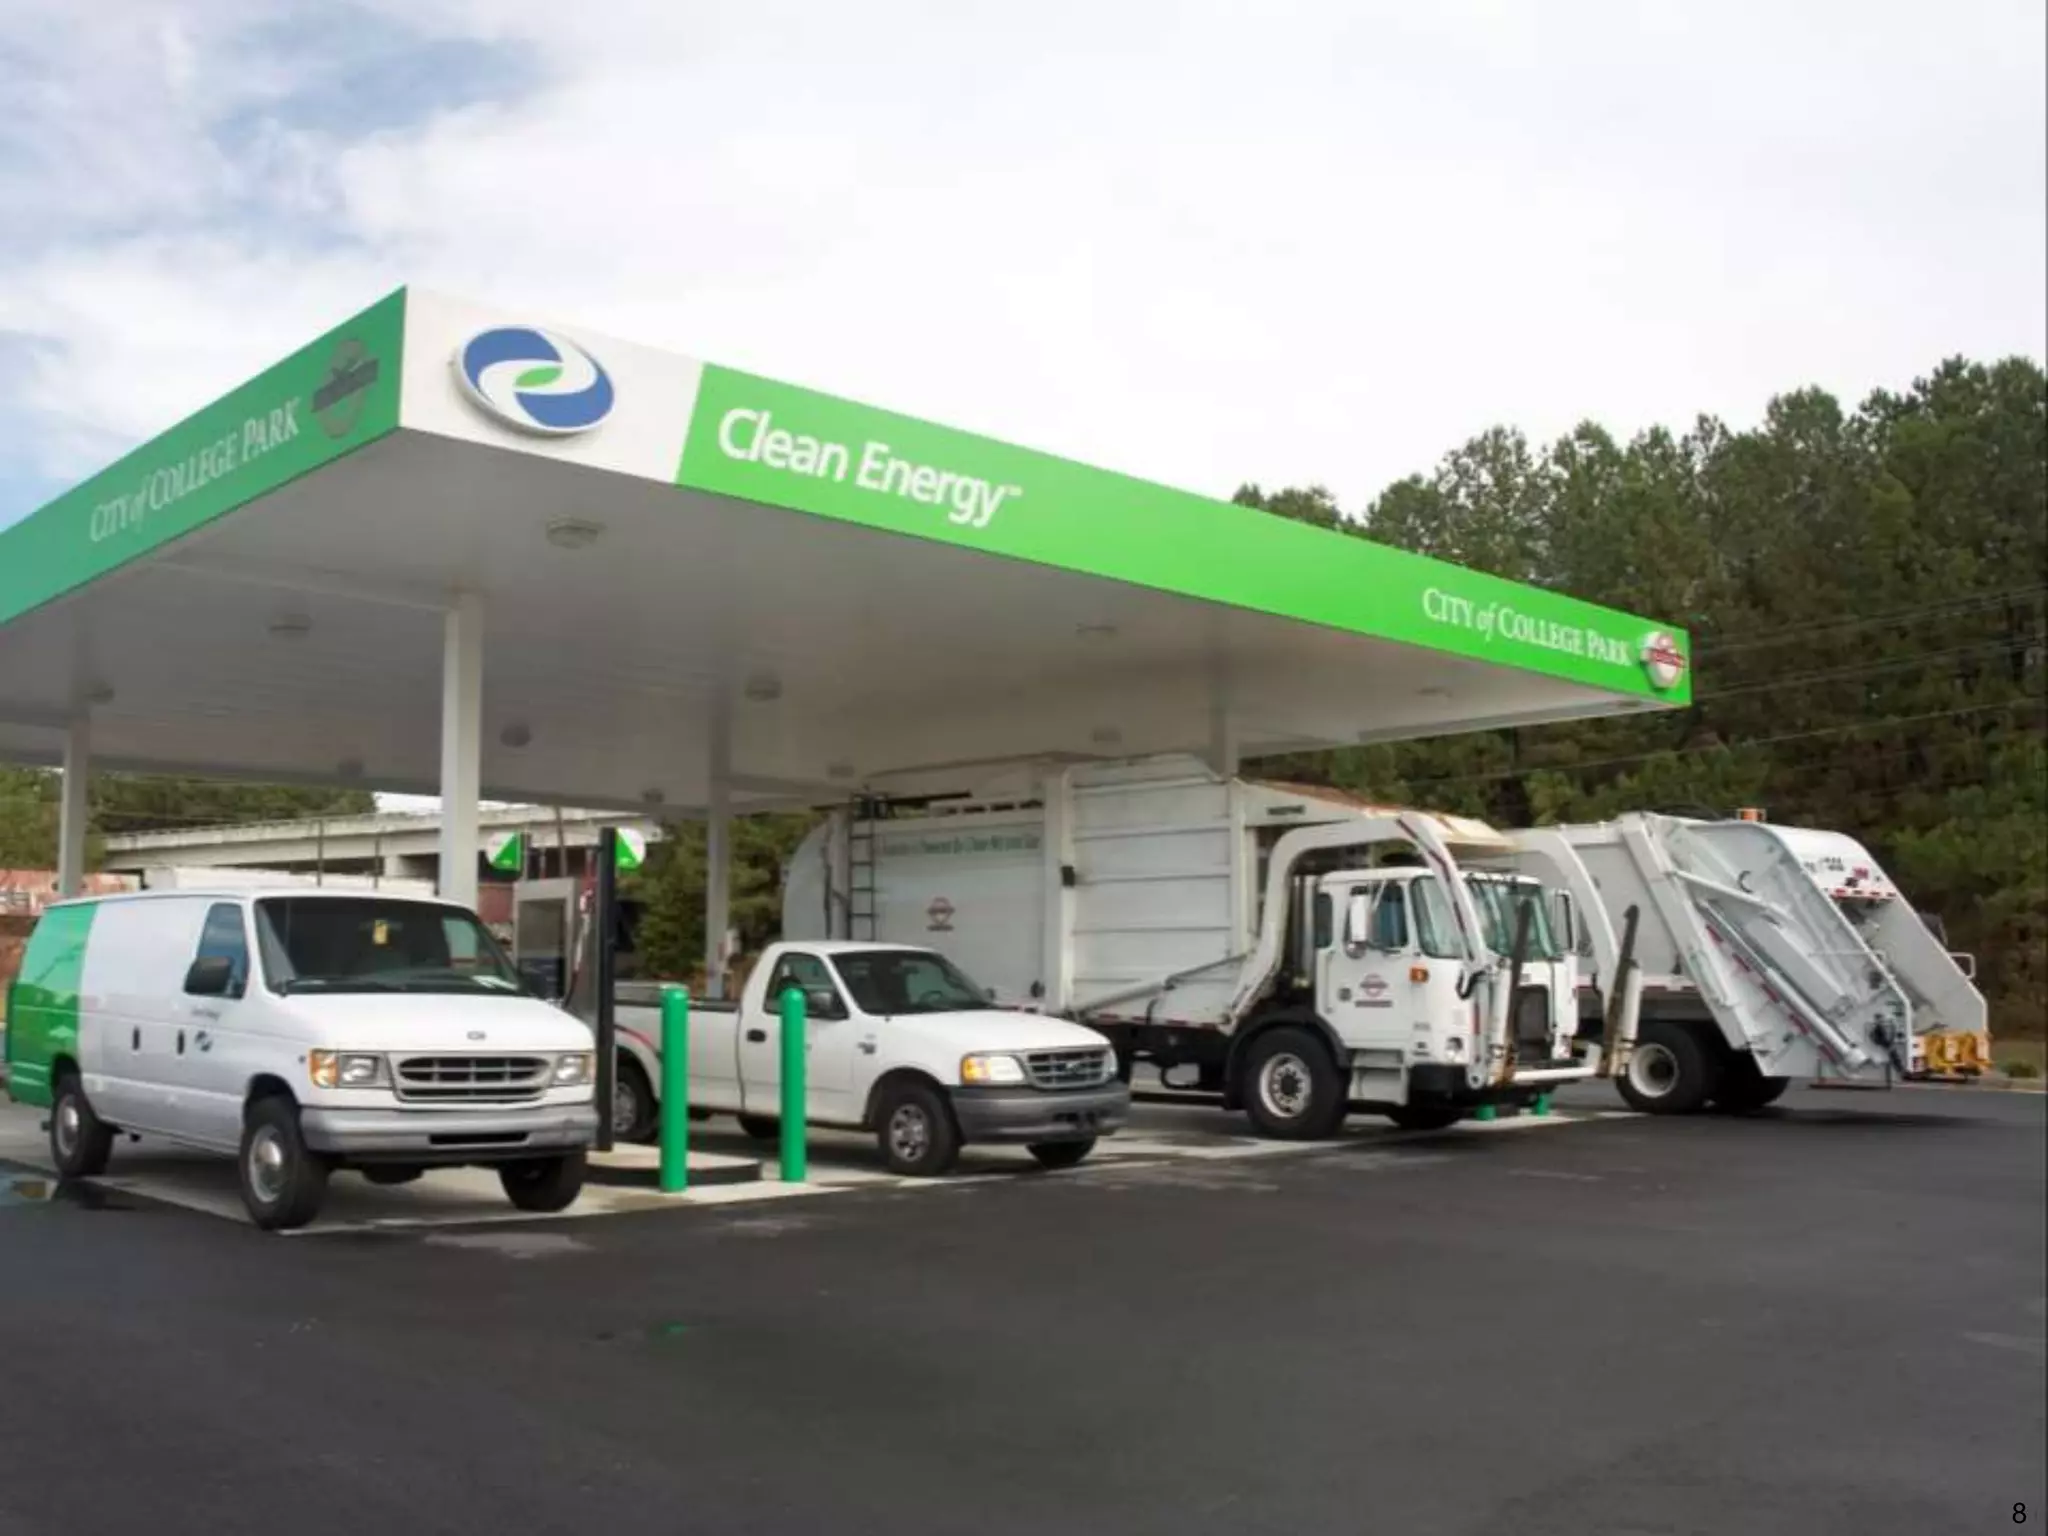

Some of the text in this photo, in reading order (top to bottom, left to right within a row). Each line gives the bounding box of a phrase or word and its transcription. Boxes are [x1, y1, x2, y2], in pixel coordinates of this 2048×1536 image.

[89, 396, 302, 543] CITY of COLLEGE PARK
[717, 407, 850, 482] Clean
[1422, 587, 1475, 630] CITY
[1475, 601, 1498, 641] of
[1499, 606, 1583, 656] COLLEGE
[1586, 628, 1632, 666] PARK
